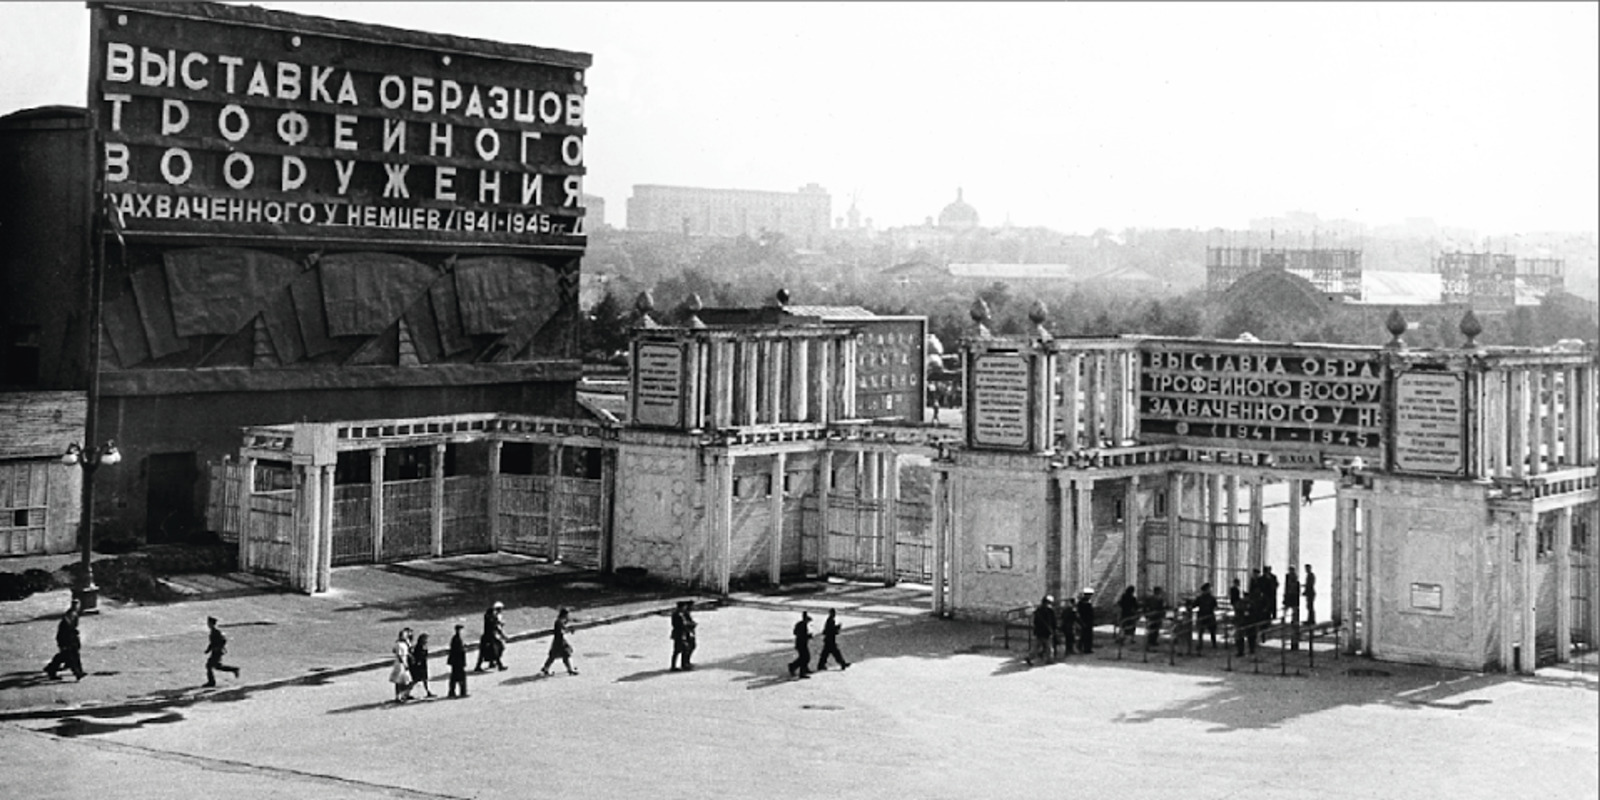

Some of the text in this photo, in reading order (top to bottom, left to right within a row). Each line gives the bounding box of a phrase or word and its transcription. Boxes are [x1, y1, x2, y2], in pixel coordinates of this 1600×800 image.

[106, 42, 584, 127] ВЫСТАВКА ОБРАЗЦОВ
[104, 142, 584, 208] ВООРУЖЕНИЯ
[324, 203, 338, 226] У
[348, 204, 440, 231] НЕМЦЕВ
[1151, 352, 1373, 378] ВЫСТАВКА ОБРА
[1300, 381, 1379, 403] ВООРУ
[1149, 397, 1319, 422] ЗАХВАЧЕННОГО
[1332, 407, 1344, 425] У
